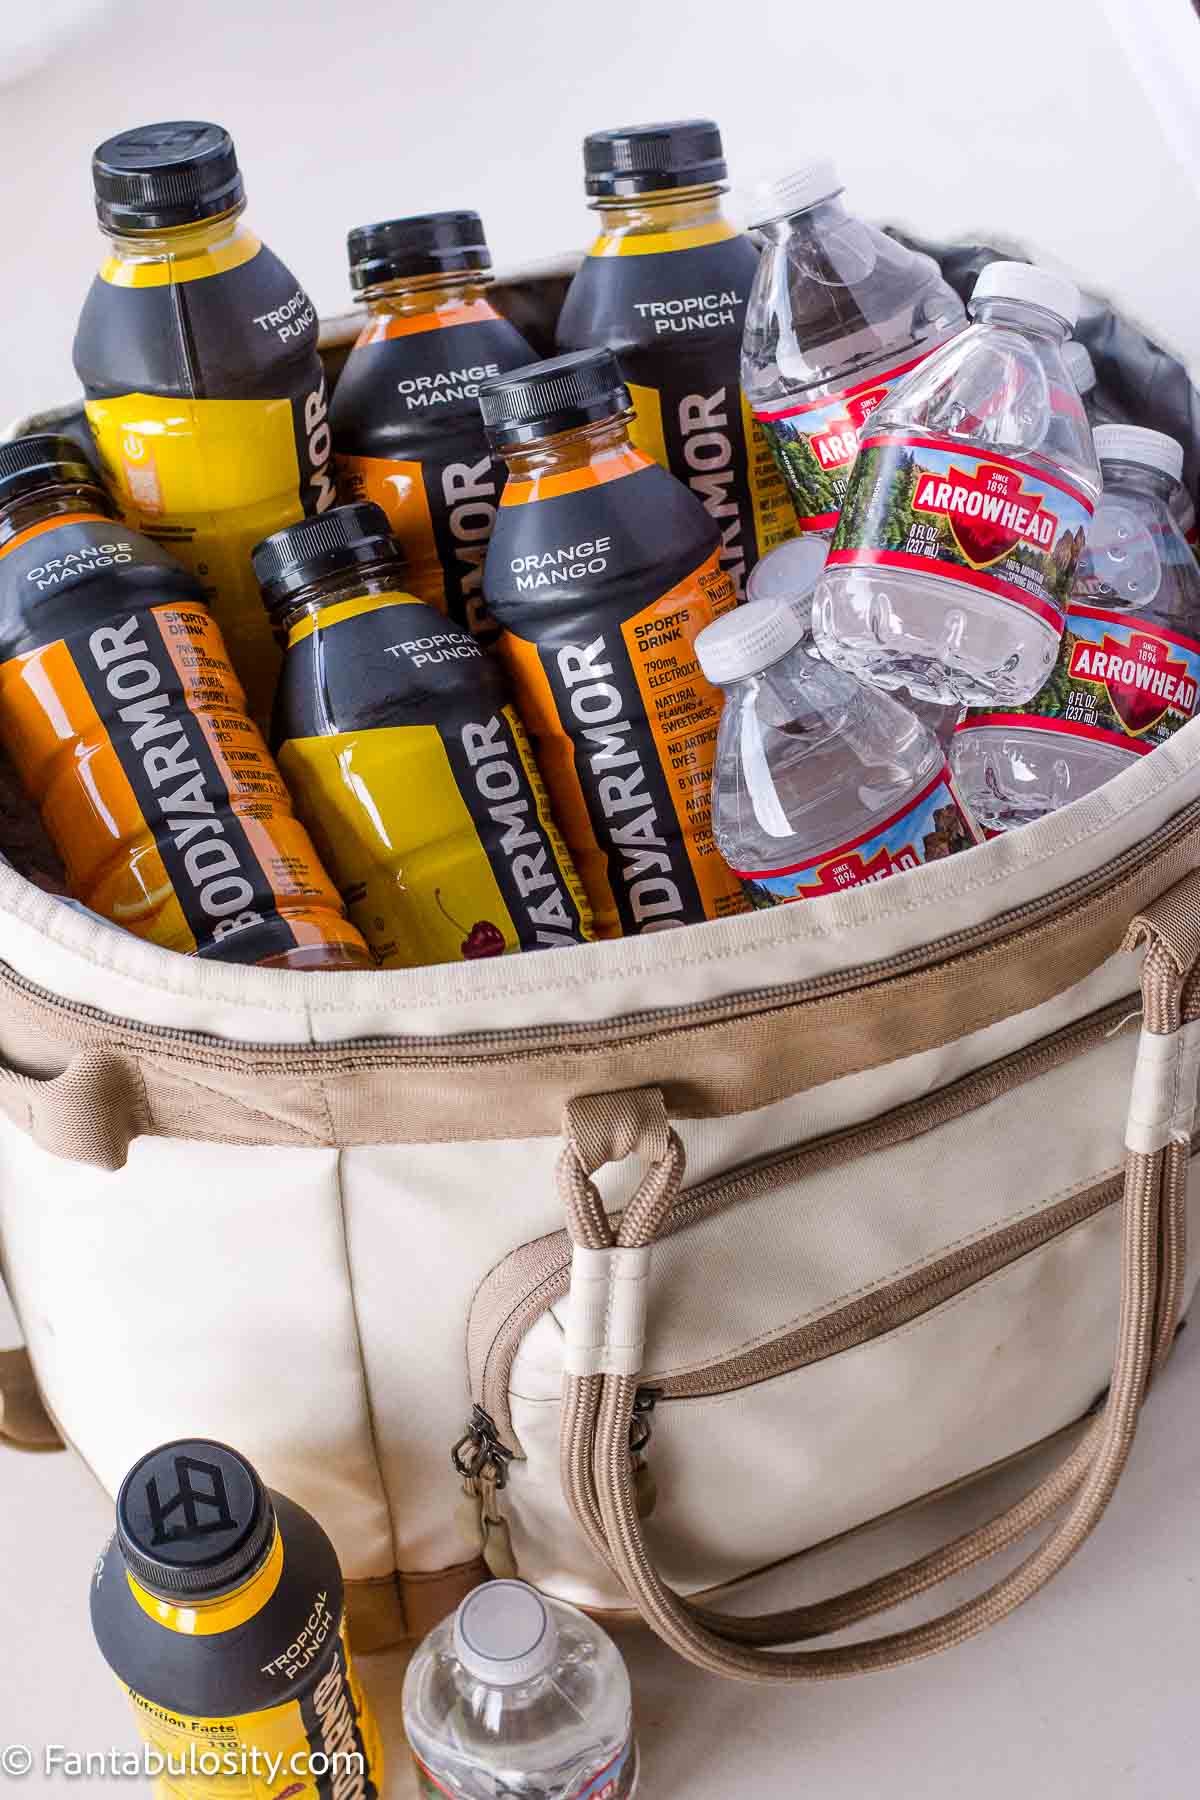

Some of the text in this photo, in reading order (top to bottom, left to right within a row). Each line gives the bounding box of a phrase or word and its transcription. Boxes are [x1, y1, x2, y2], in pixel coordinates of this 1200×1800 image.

[634, 291, 743, 318] TROPICAL
[655, 310, 736, 334] PUNCH
[398, 363, 500, 394] ORANGE
[406, 383, 481, 410] MANG
[987, 480, 1009, 496] 1894
[991, 472, 1008, 484] SINCE
[918, 480, 1053, 545] ARROWHEAD
[909, 523, 938, 541] 8 FL OZ
[511, 536, 611, 573] ORANGE
[906, 540, 939, 558] (237 mL)
[27, 543, 133, 581] ORANGE
[36, 553, 132, 591] MANGO
[516, 557, 607, 591] MANGO
[634, 609, 690, 638] SPORTS
[638, 627, 683, 653] DRINK
[1142, 641, 1157, 653] SINCE
[411, 645, 482, 668] PUNCH
[644, 656, 678, 673] 790mg
[1138, 649, 1157, 665] 1894
[1074, 649, 1194, 709] ARROWHEAD
[655, 687, 697, 710] NATURAL
[1068, 691, 1097, 709] 8 FL OZ
[1066, 705, 1099, 726] (237 mL)
[667, 740, 683, 756] NO
[672, 752, 697, 769] DYES
[89, 615, 264, 943] BODYARMOR
[678, 778, 686, 789] 8
[832, 863, 849, 876] SINCE
[833, 869, 856, 886] 1894
[261, 1591, 327, 1676] TROPICAL
[285, 1611, 333, 1679] PUNCH
[128, 1688, 235, 1733] Nutrition Facts
